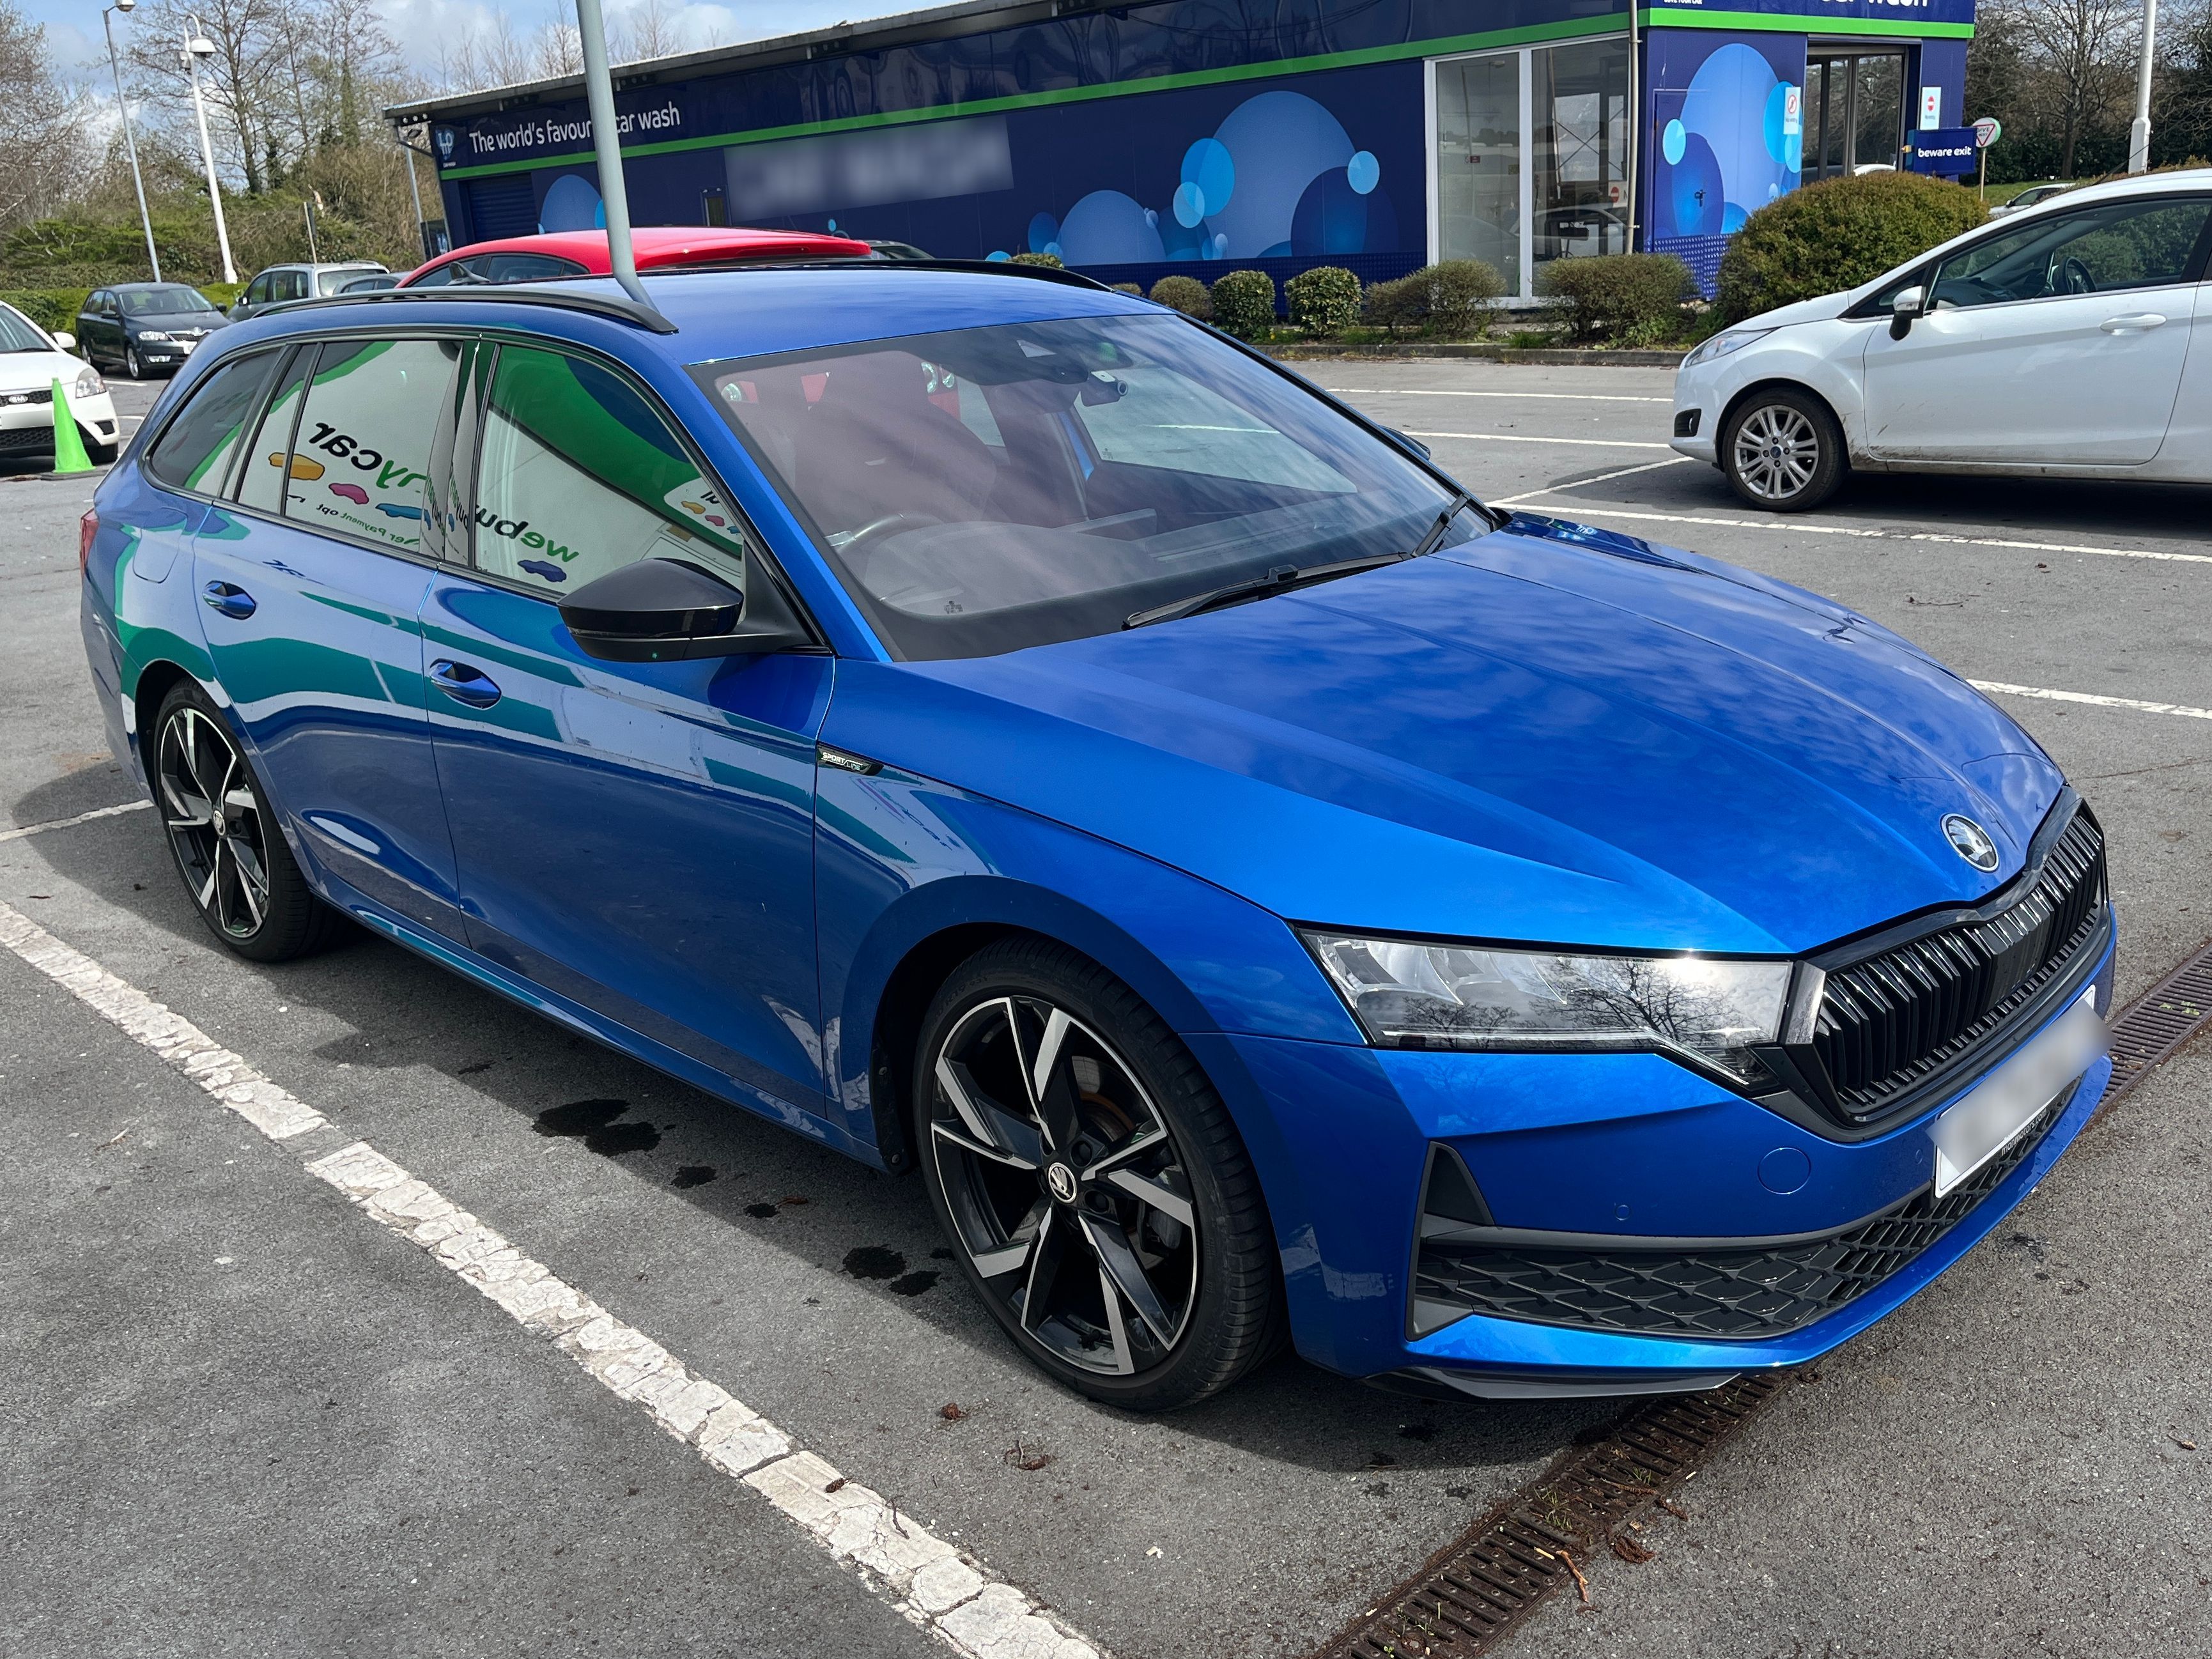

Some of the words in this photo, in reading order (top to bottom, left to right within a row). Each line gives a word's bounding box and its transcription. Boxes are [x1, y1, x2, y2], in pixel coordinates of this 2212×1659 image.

[469, 130, 495, 153] The
[496, 122, 544, 150] world's
[546, 120, 592, 143] favour
[638, 101, 681, 130] wash
[1918, 148, 1953, 158] beware
[1954, 146, 1972, 156] exit
